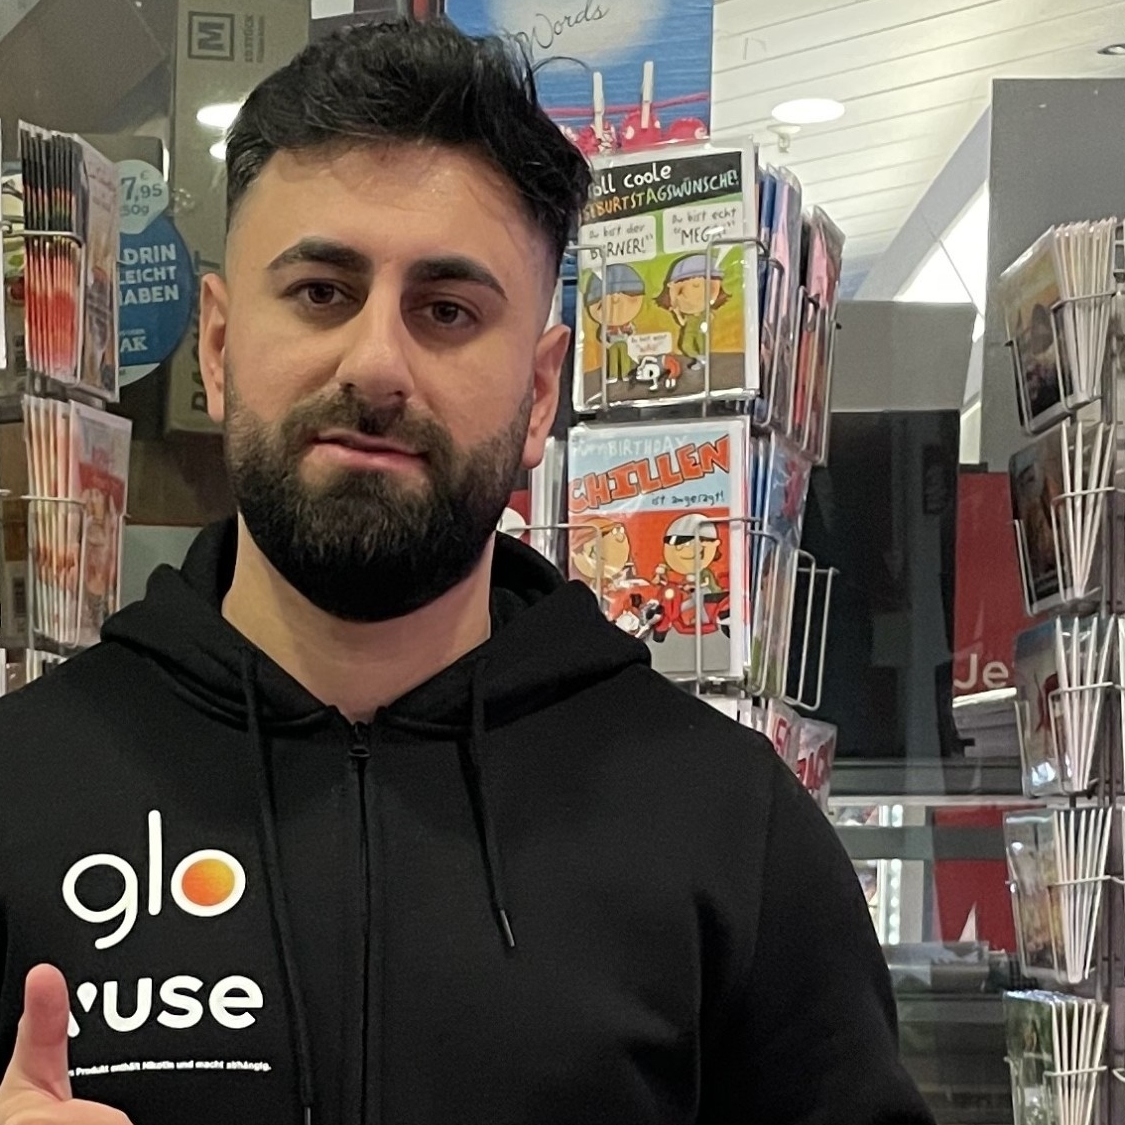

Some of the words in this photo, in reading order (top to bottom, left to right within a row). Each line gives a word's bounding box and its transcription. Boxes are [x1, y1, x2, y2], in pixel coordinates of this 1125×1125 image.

[588, 172, 616, 197] oll
[624, 162, 672, 188] coole
[568, 433, 730, 514] CHILLEN
[62, 809, 246, 950] glo
[76, 1065, 109, 1077] Produkt
[176, 1060, 194, 1070] und
[195, 1060, 224, 1069] macht
[226, 1060, 272, 1072] abhängig.
